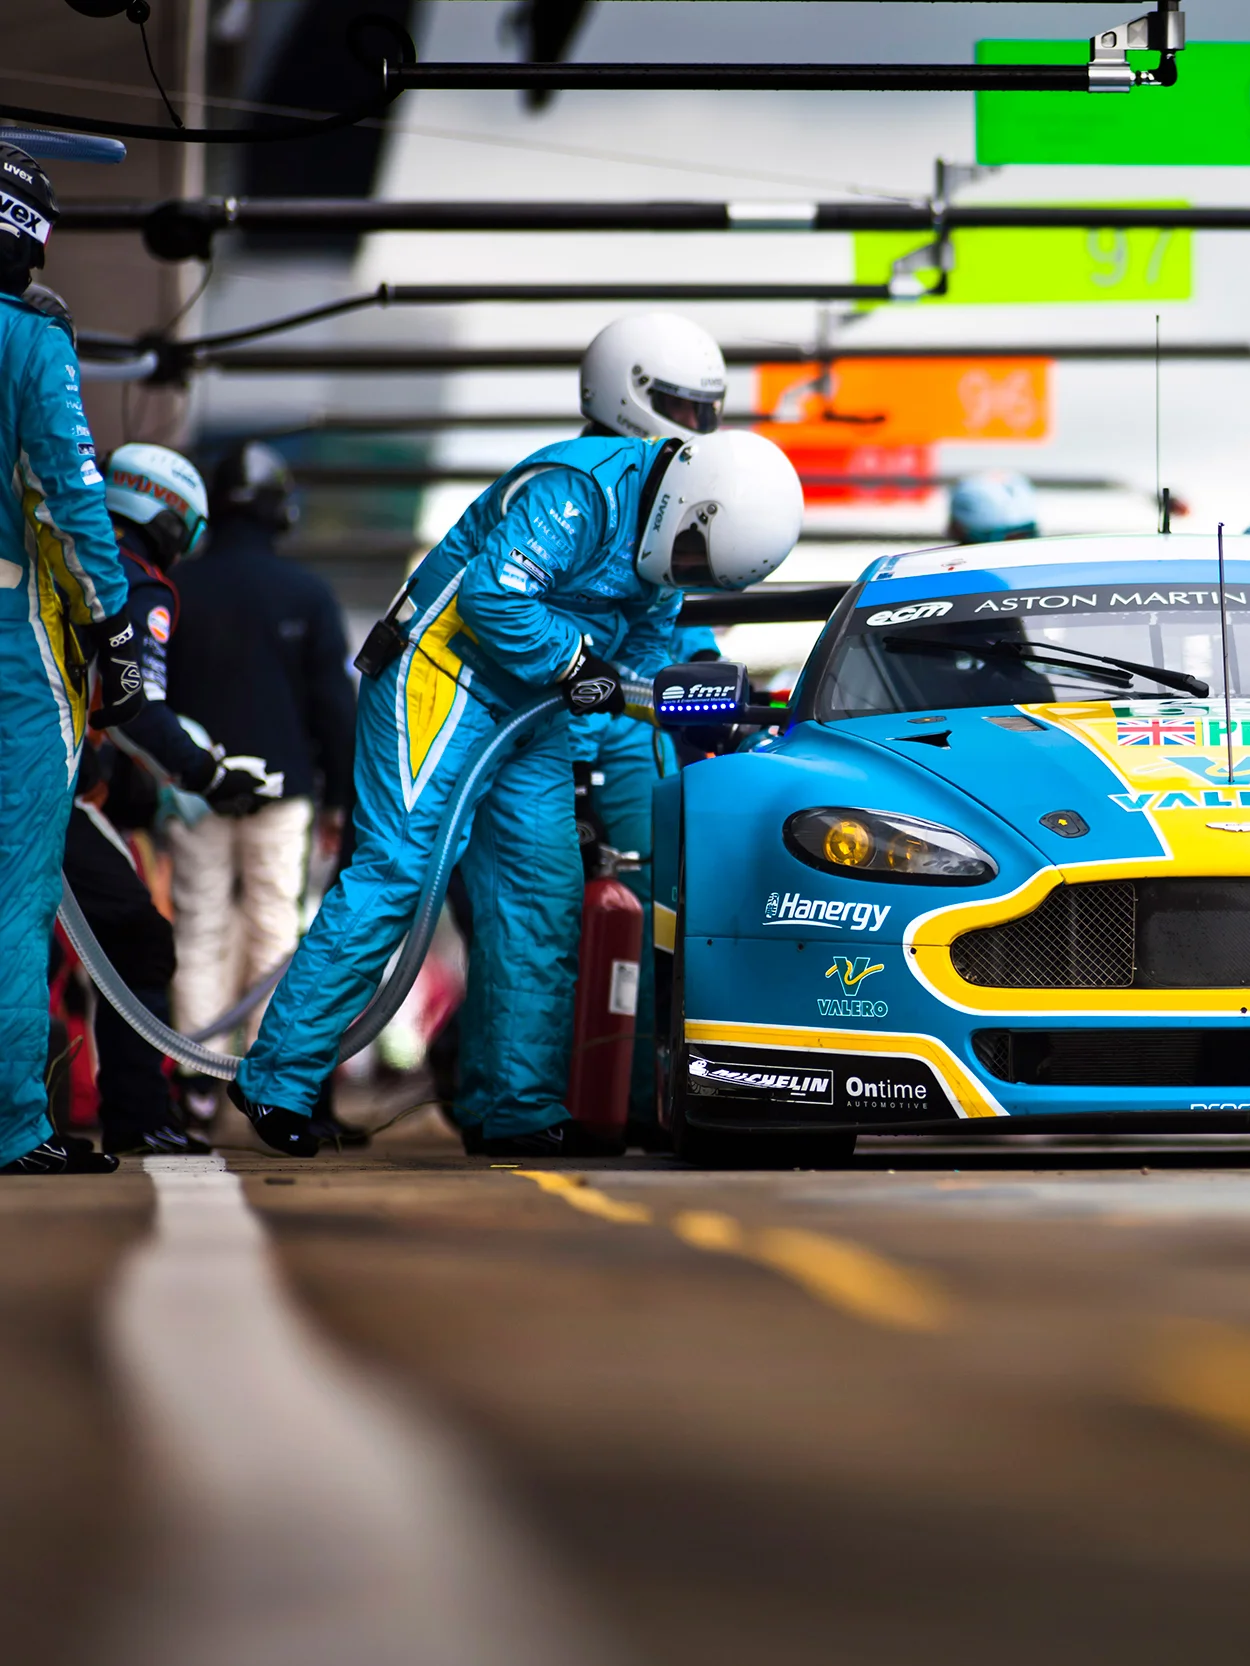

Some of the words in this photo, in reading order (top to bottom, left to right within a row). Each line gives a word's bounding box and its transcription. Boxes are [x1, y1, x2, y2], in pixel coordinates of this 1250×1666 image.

[3, 162, 34, 185] uvex
[0, 195, 41, 234] vex
[1086, 227, 1174, 288] 97
[652, 493, 671, 533] uvex
[974, 593, 1096, 613] ASTON
[1110, 591, 1247, 606] MARTIN
[688, 684, 735, 698] fmr
[778, 893, 891, 932] Hanergy
[817, 999, 889, 1018] VALERO
[711, 1069, 830, 1093] MICHELIN
[846, 1076, 928, 1099] Ontime
[846, 1101, 928, 1110] AUTOMOTIVE
